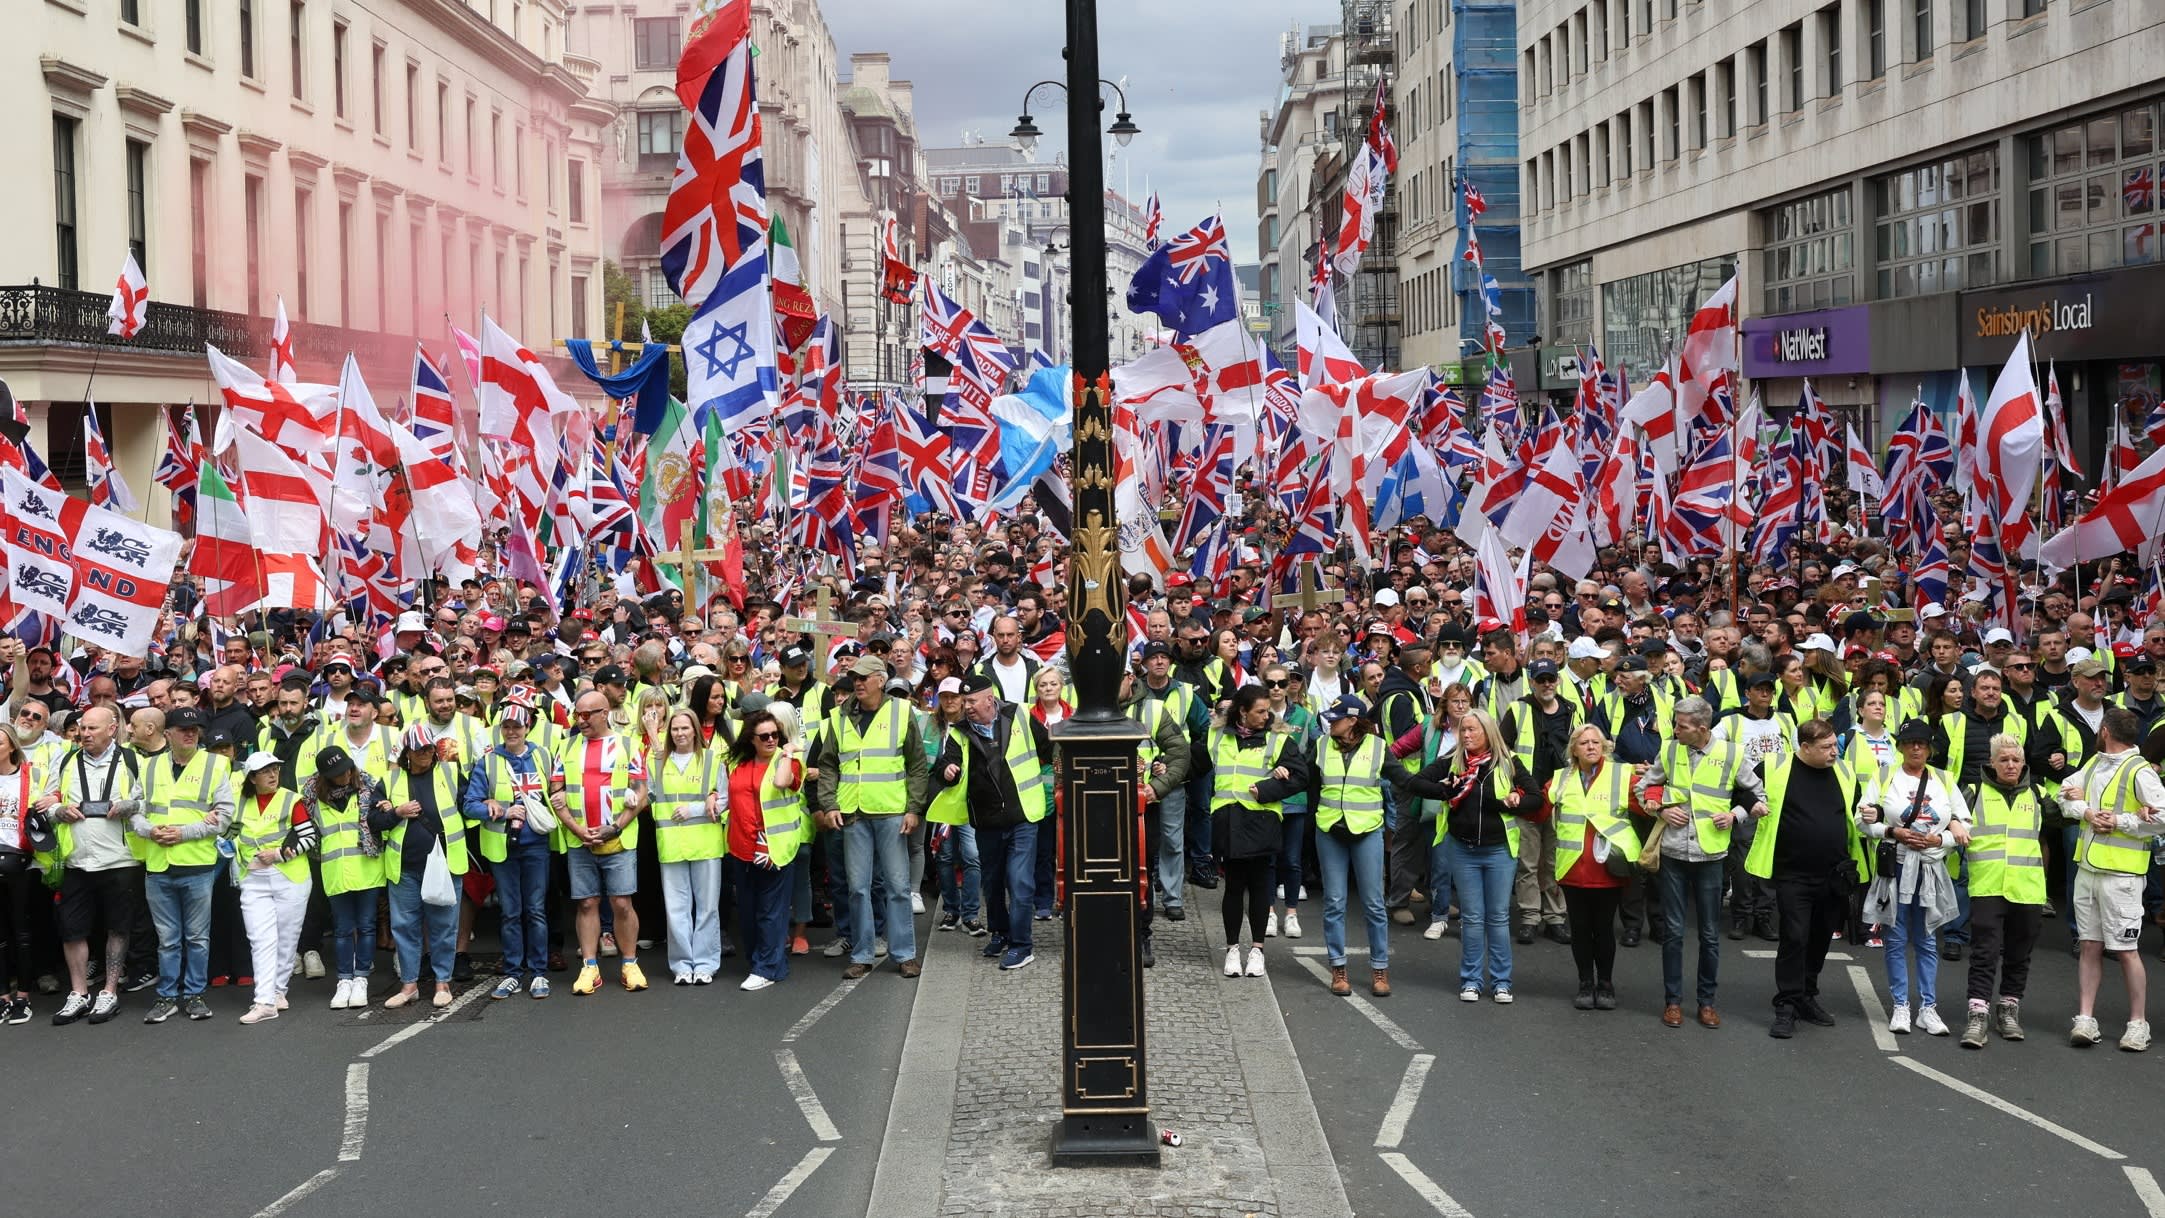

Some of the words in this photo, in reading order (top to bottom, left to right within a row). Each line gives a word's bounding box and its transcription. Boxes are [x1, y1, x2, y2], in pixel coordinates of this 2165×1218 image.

[1977, 302, 2051, 340] Sainsbury's
[2054, 294, 2092, 330] Local
[1781, 328, 1825, 361] NatWest
[960, 378, 986, 408] NITE
[17, 527, 136, 597] ENGND
